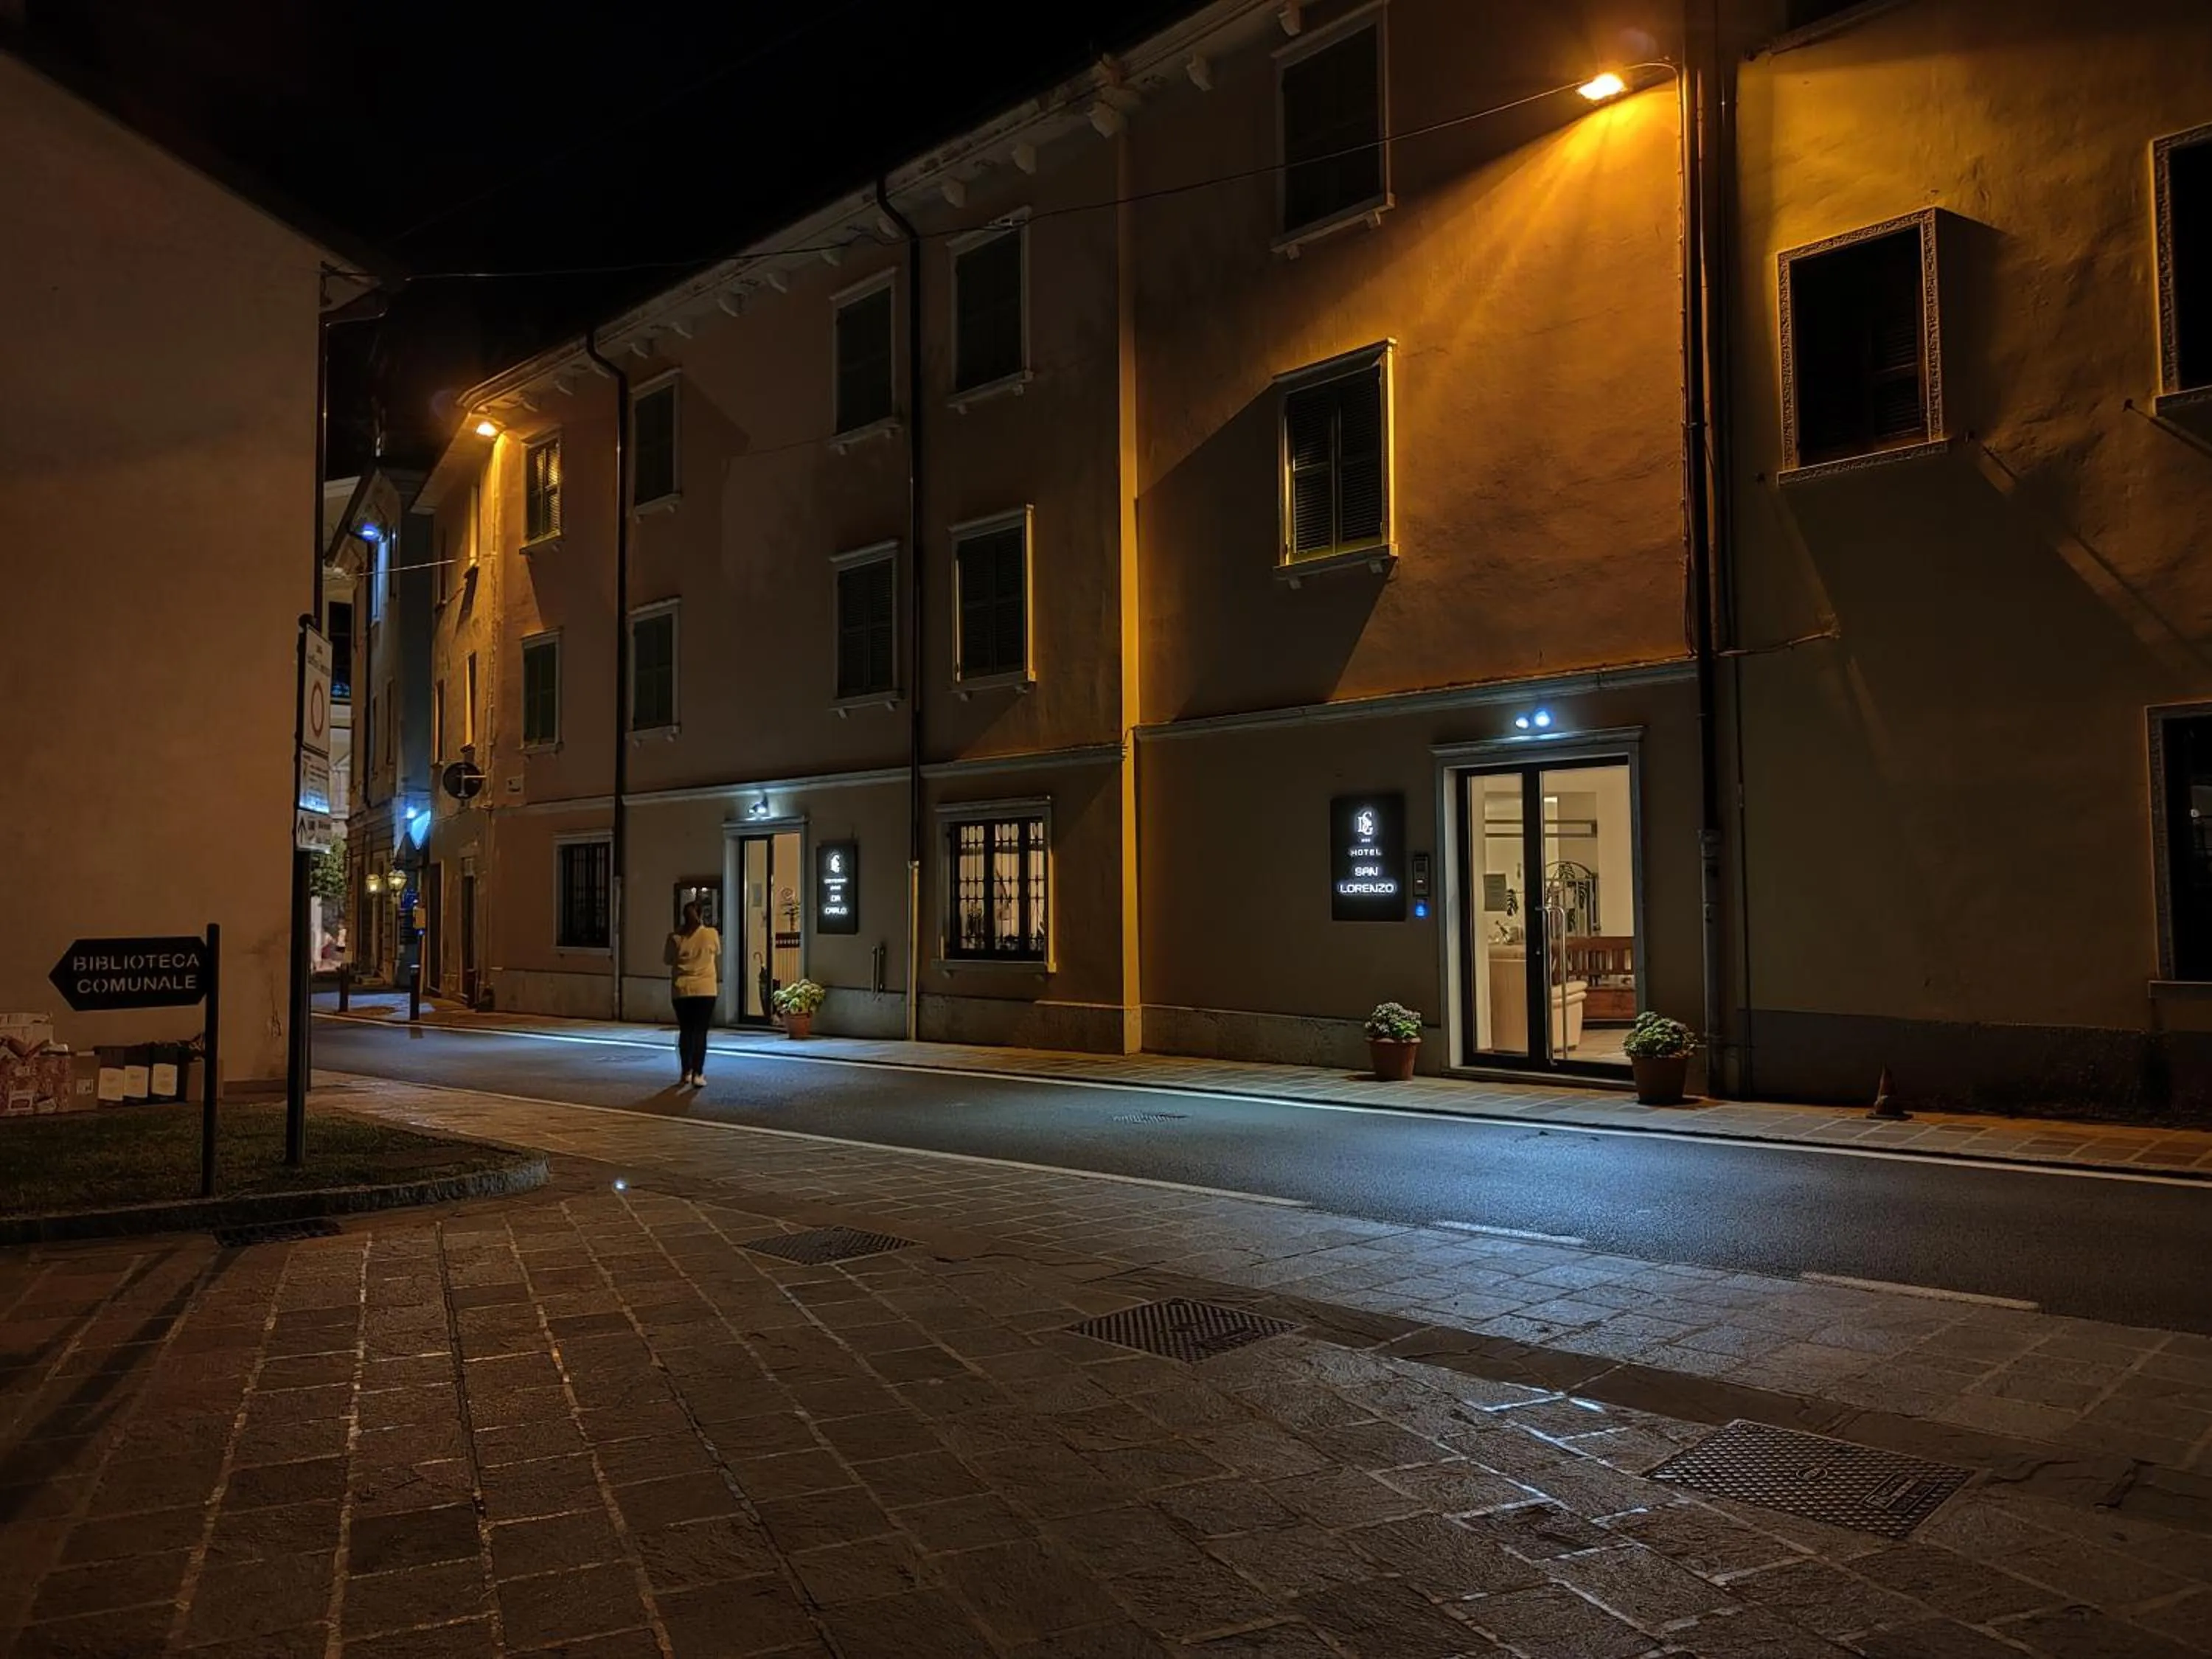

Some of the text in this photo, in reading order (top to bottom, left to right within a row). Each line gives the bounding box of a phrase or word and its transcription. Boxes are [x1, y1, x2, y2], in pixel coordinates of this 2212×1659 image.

[1354, 866, 1378, 876] SAN
[1340, 883, 1394, 893] LORENZO
[74, 953, 200, 971] BIBLIOTECA
[77, 974, 197, 993] COMUNALE
